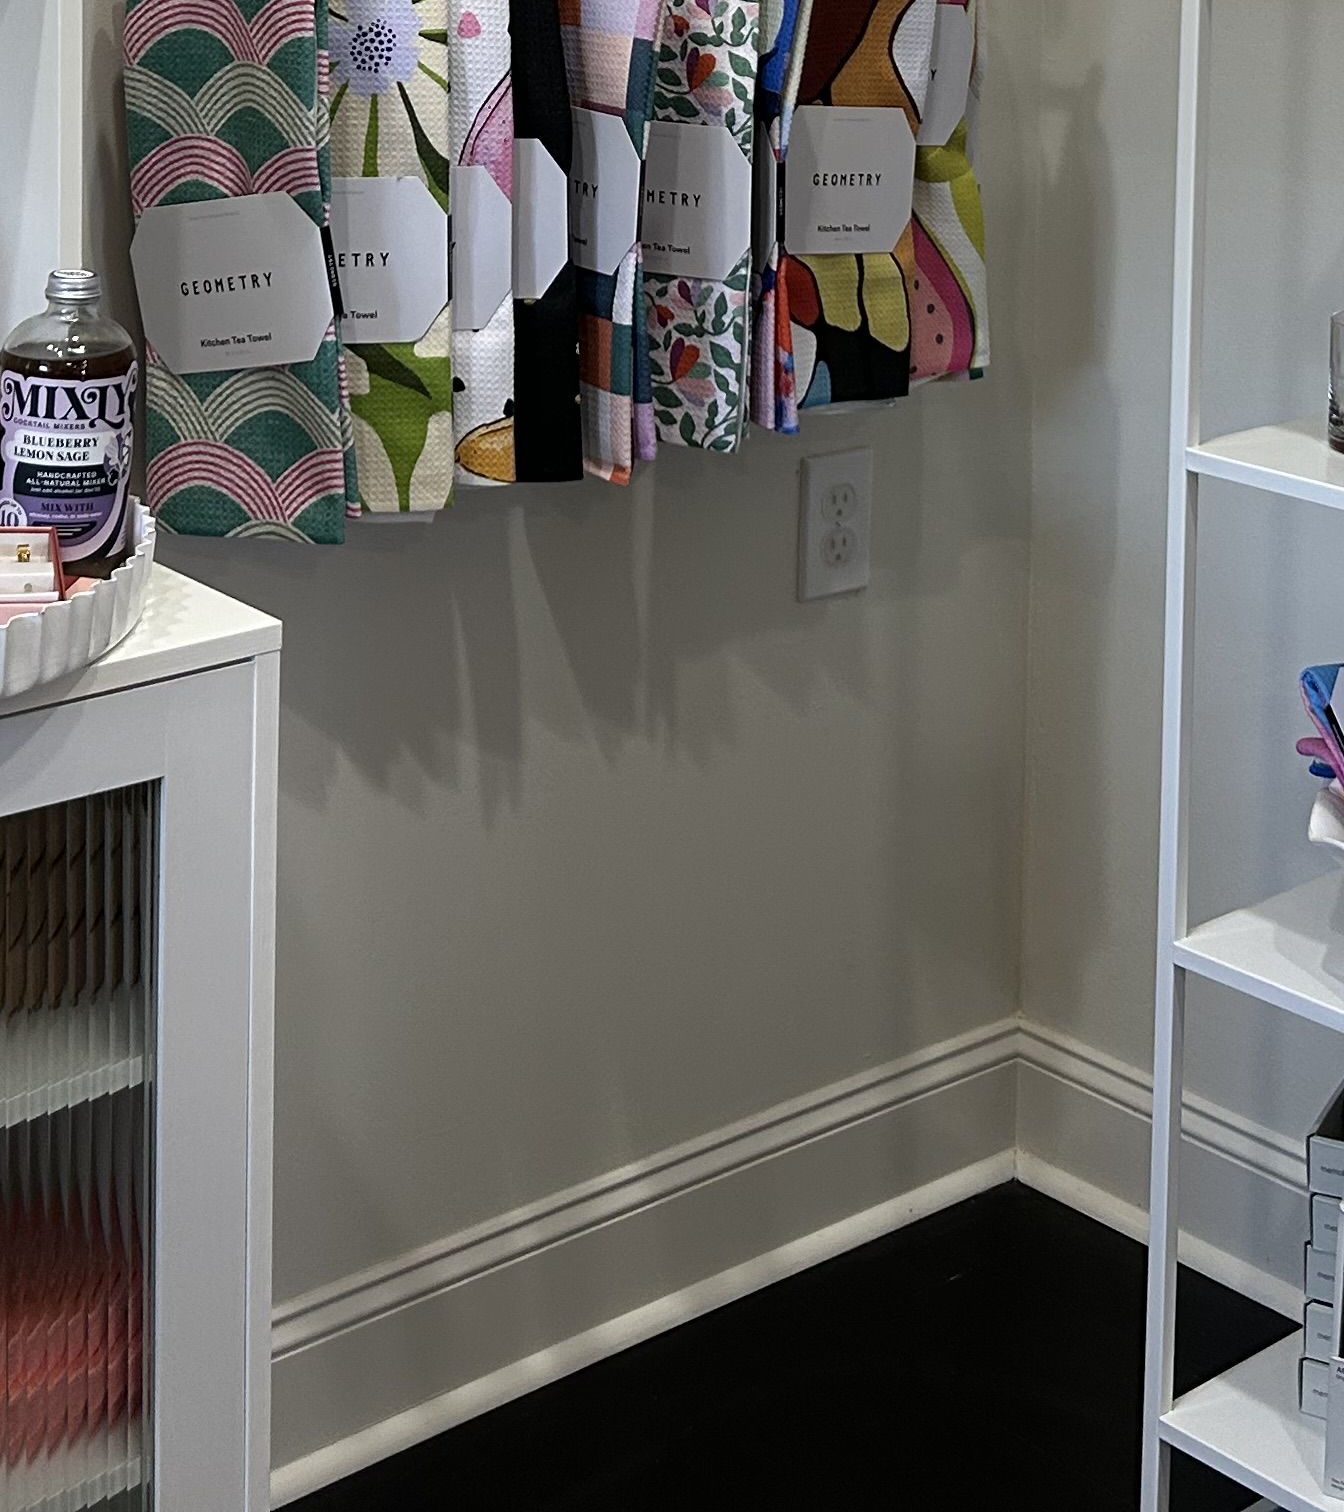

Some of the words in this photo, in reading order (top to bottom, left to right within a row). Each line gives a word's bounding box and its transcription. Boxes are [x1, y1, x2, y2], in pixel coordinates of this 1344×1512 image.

[813, 173, 882, 187] GEOMETRY
[667, 244, 691, 255] Towel
[180, 272, 273, 296] GEOMETRY
[350, 310, 377, 319] Towel
[200, 336, 230, 348] Kitchen
[232, 334, 246, 345] Tea
[247, 332, 272, 343] Towel
[2, 368, 137, 429] MIXLY
[13, 417, 51, 429] COCKTAIL
[23, 434, 99, 448] BLUEBERRY
[14, 445, 54, 461] LEMON
[57, 451, 89, 461] SAGE
[37, 471, 97, 479] HANDCRAFTED
[41, 502, 62, 511] MIX
[64, 501, 94, 511] WITH
[0, 509, 19, 527] 10
